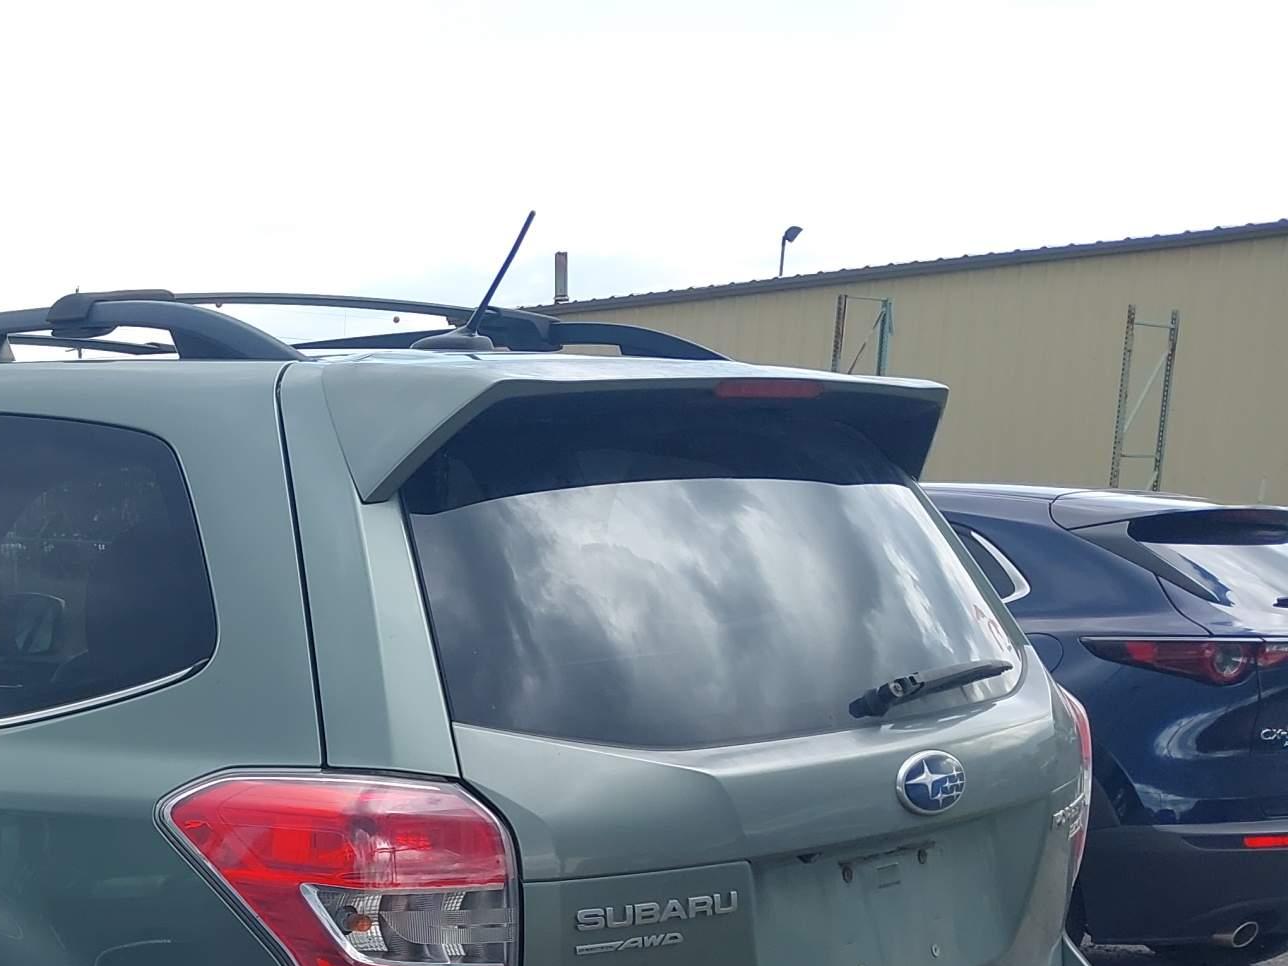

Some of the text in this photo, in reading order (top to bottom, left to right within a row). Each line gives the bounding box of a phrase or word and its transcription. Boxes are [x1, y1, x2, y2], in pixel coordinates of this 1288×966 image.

[1260, 728, 1288, 741] CX-
[575, 890, 739, 931] SUBARU
[617, 932, 684, 951] AWD
